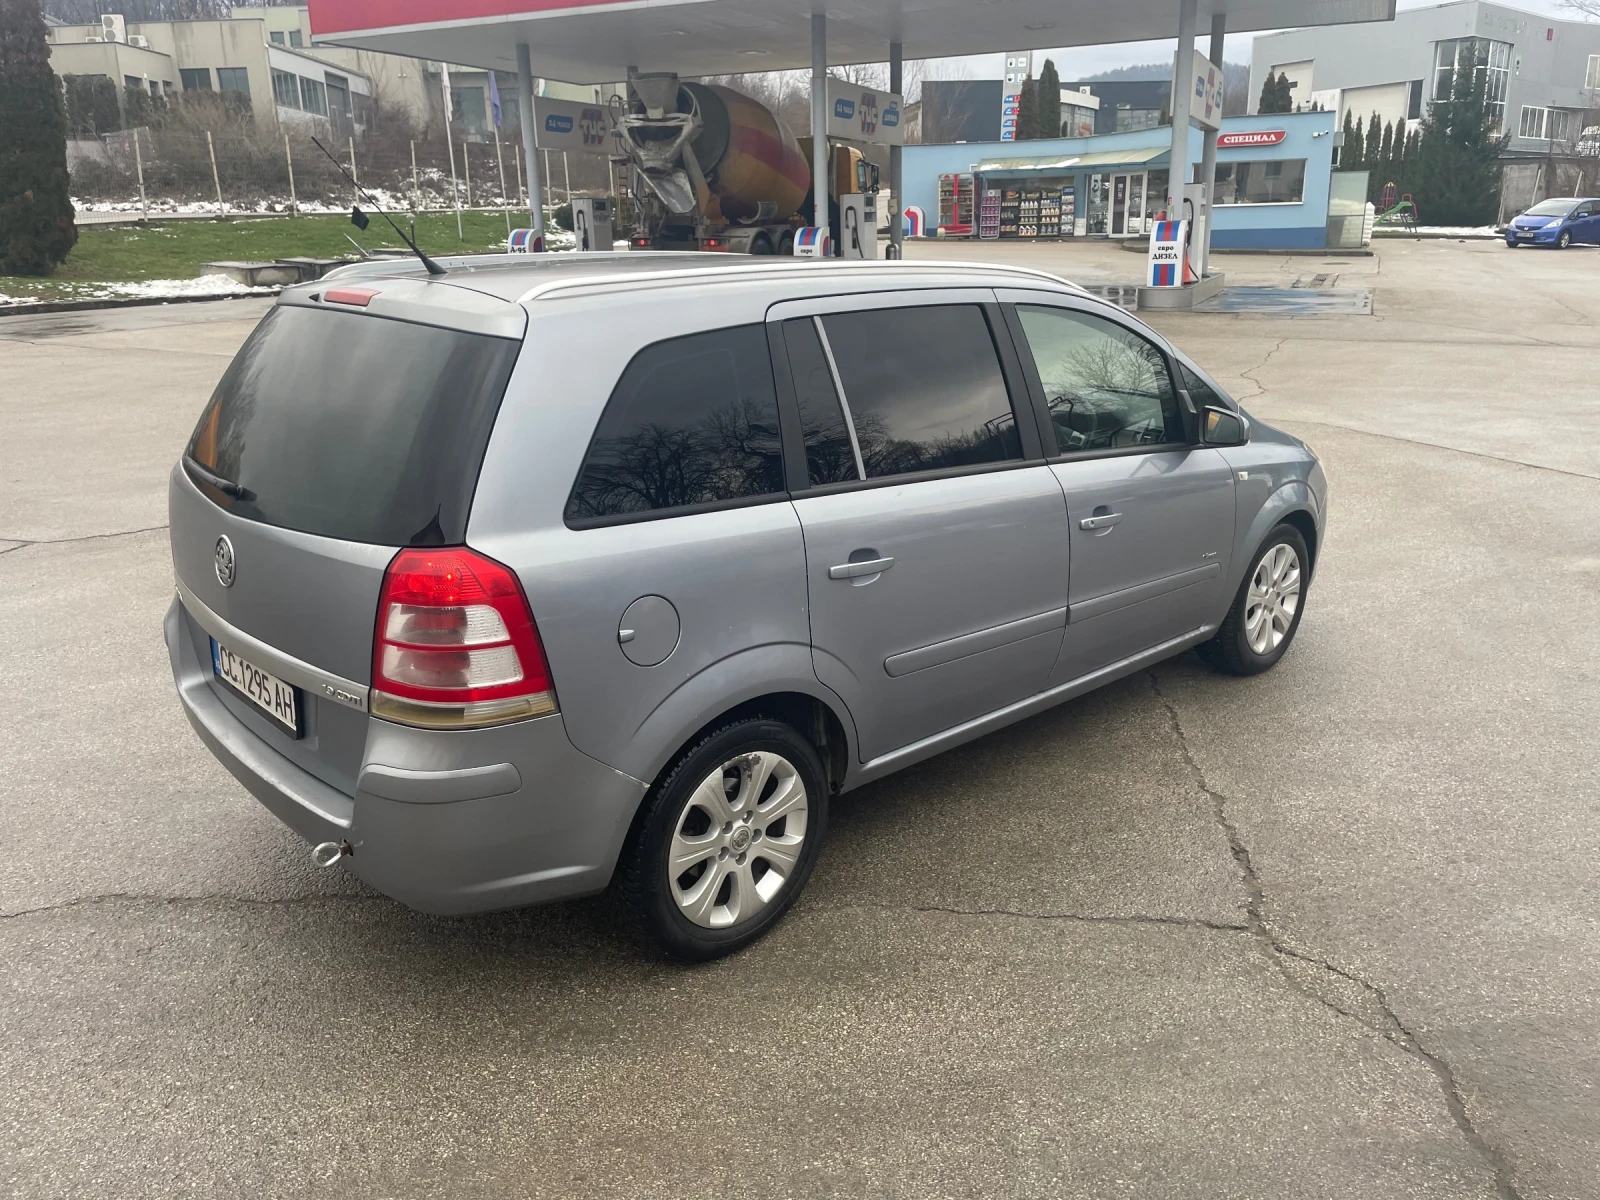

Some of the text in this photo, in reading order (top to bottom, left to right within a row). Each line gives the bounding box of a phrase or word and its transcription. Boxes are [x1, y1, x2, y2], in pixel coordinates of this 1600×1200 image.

[1223, 133, 1277, 144] СПЕЦИАЛ
[1152, 252, 1178, 260] ДИЗЕЛ
[239, 659, 272, 707] 1295
[275, 682, 294, 724] AH
